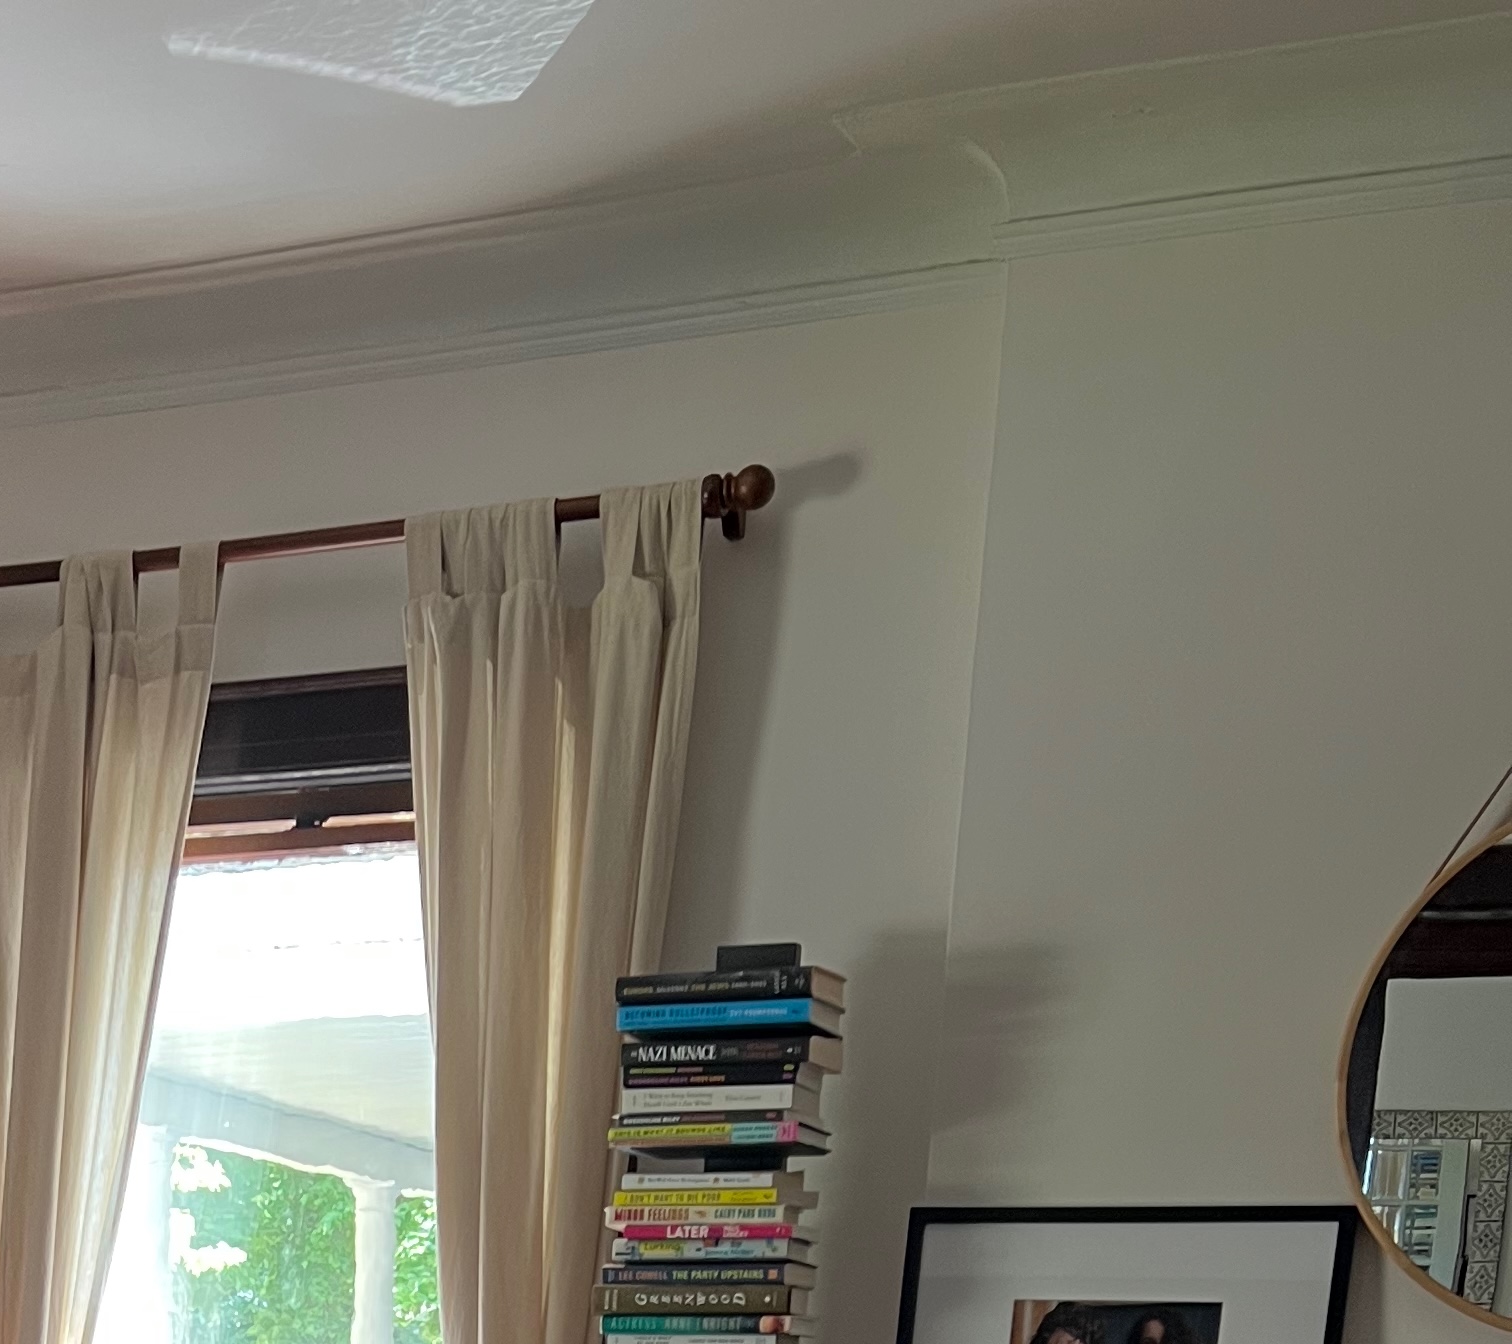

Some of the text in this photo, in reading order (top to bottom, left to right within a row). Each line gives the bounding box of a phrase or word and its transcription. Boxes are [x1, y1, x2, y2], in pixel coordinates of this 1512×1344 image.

[637, 1045, 668, 1063] NAZI
[669, 1043, 718, 1061] MENACE
[653, 1193, 674, 1203] WANT
[675, 1193, 685, 1202] TO
[701, 1192, 721, 1202] POOR
[614, 1208, 645, 1221] MINOR
[647, 1208, 690, 1221] FEELINGS
[737, 1208, 755, 1219] PARK
[666, 1225, 710, 1239] LATER
[643, 1242, 681, 1252] Lurking
[672, 1270, 689, 1280] THE
[690, 1269, 719, 1280] PARTY
[720, 1269, 764, 1280] UPSTAIRS
[634, 1291, 746, 1306] GREENWOOD
[609, 1316, 657, 1331] ACTRESS
